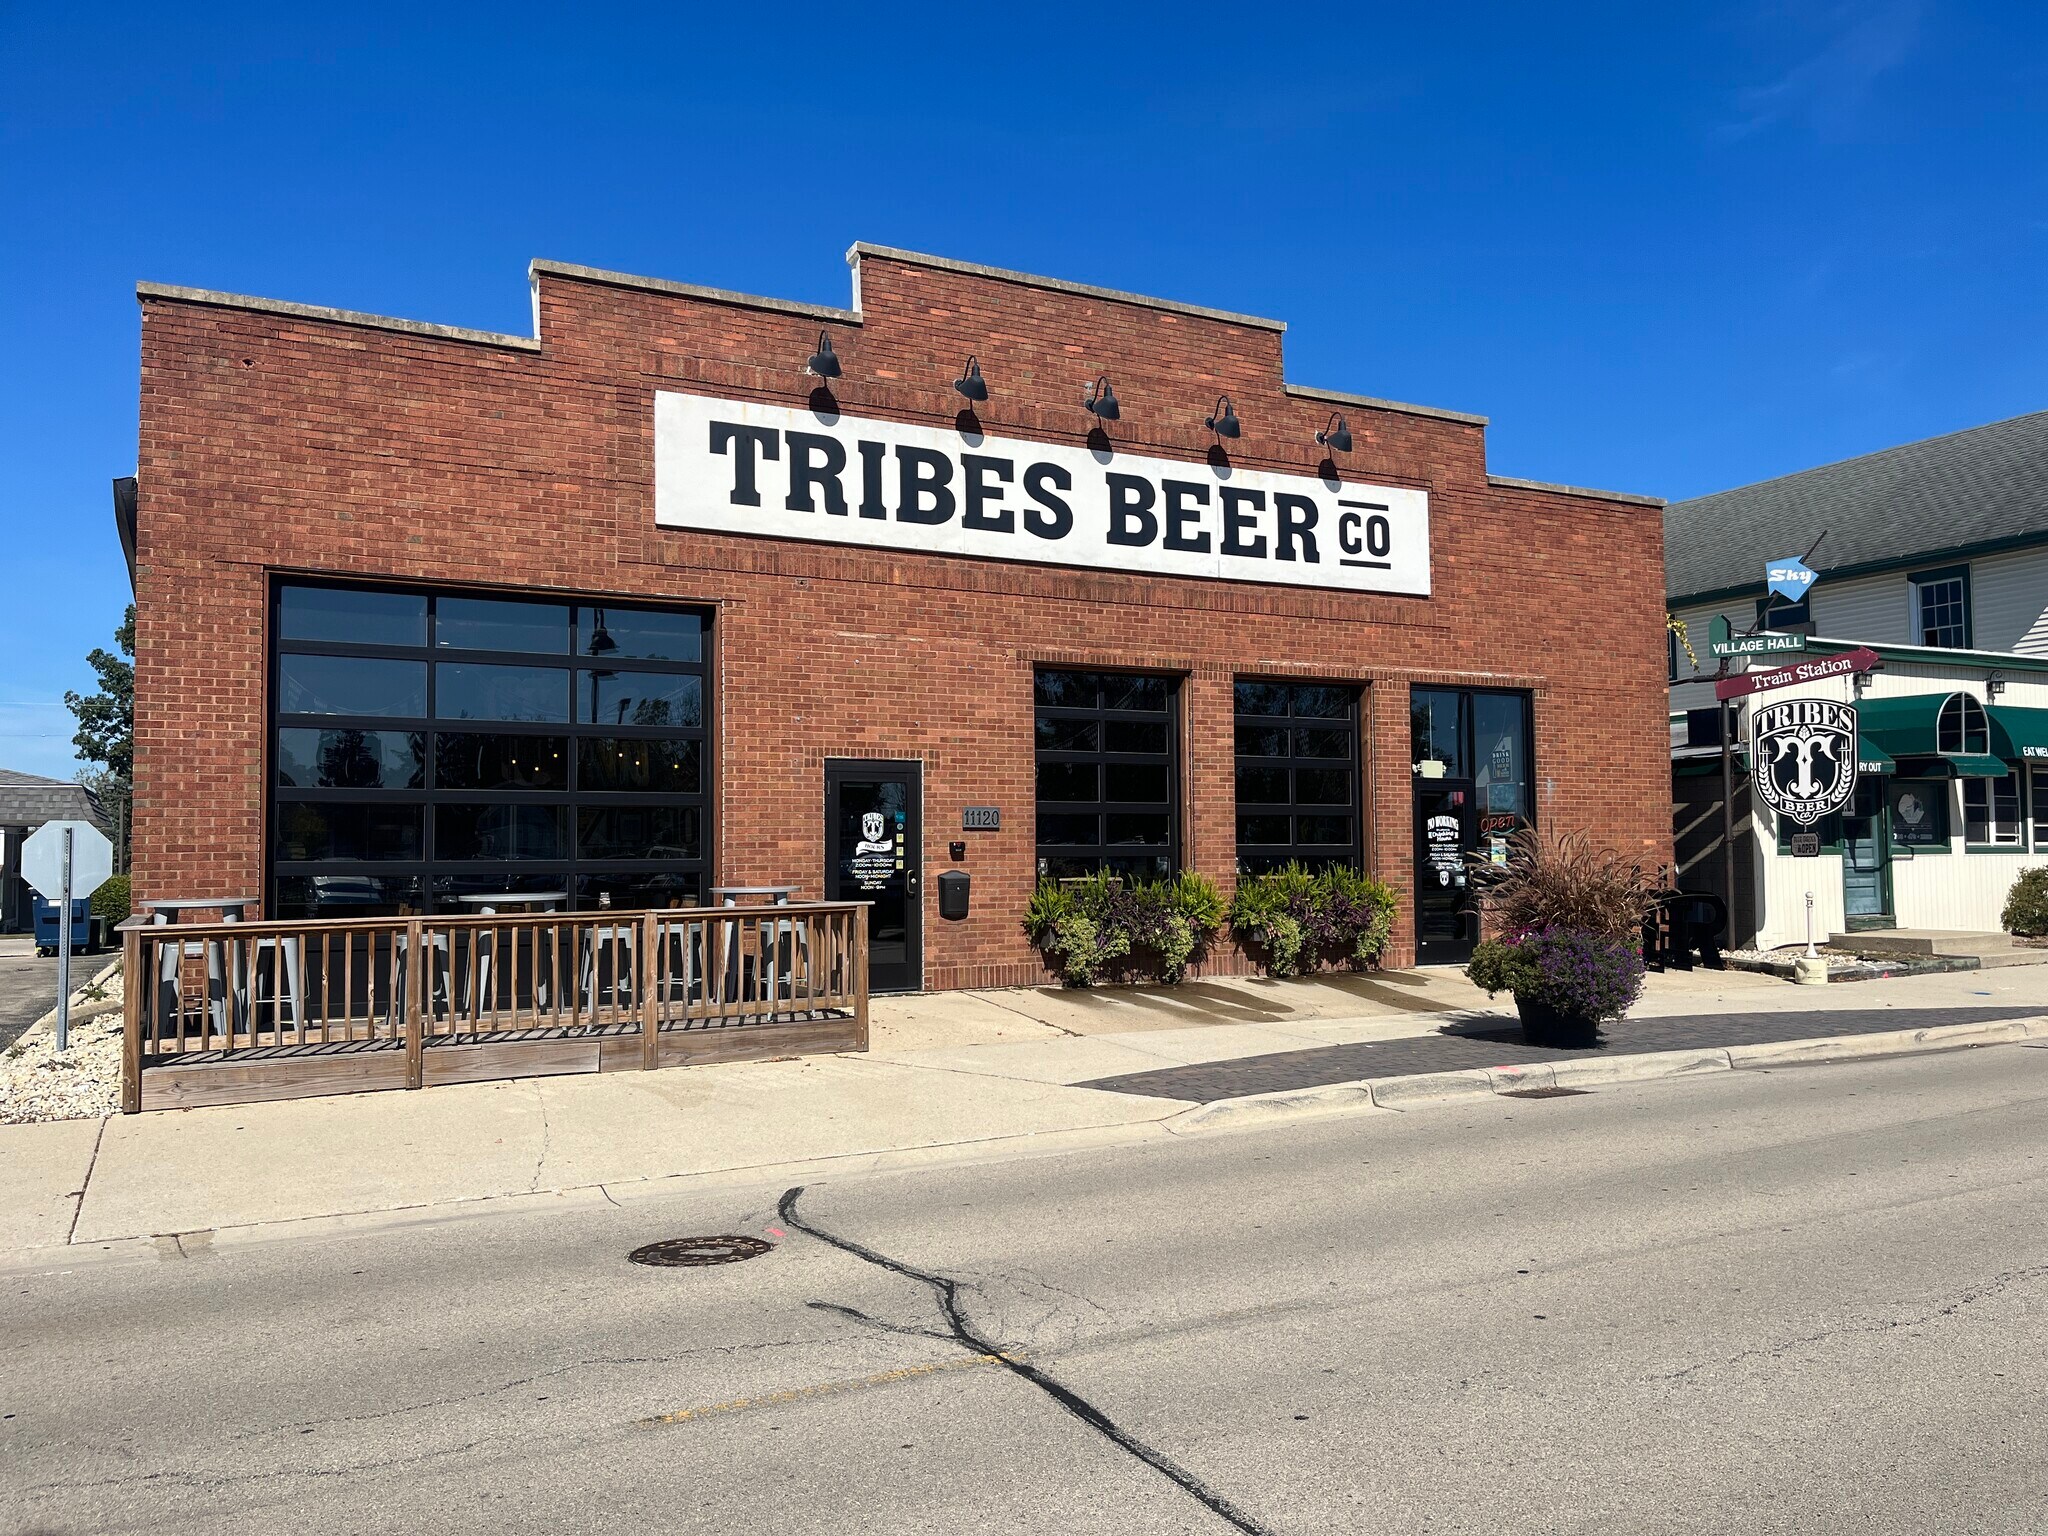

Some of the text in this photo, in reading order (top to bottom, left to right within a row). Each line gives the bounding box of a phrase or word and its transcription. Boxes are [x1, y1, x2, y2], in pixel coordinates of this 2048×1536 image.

[710, 421, 1391, 564] TRIBES BEER CO
[1768, 569, 1812, 585] Sky
[1713, 637, 1802, 655] VILLAGE HALL
[1751, 660, 1852, 690] Train Station
[1757, 702, 1853, 735] TRIBES
[2022, 746, 2035, 757] EAT
[1868, 762, 1882, 772] OUT
[1785, 800, 1827, 812] BEER
[964, 810, 999, 826] 11120
[1427, 815, 1459, 831] NO WORKING
